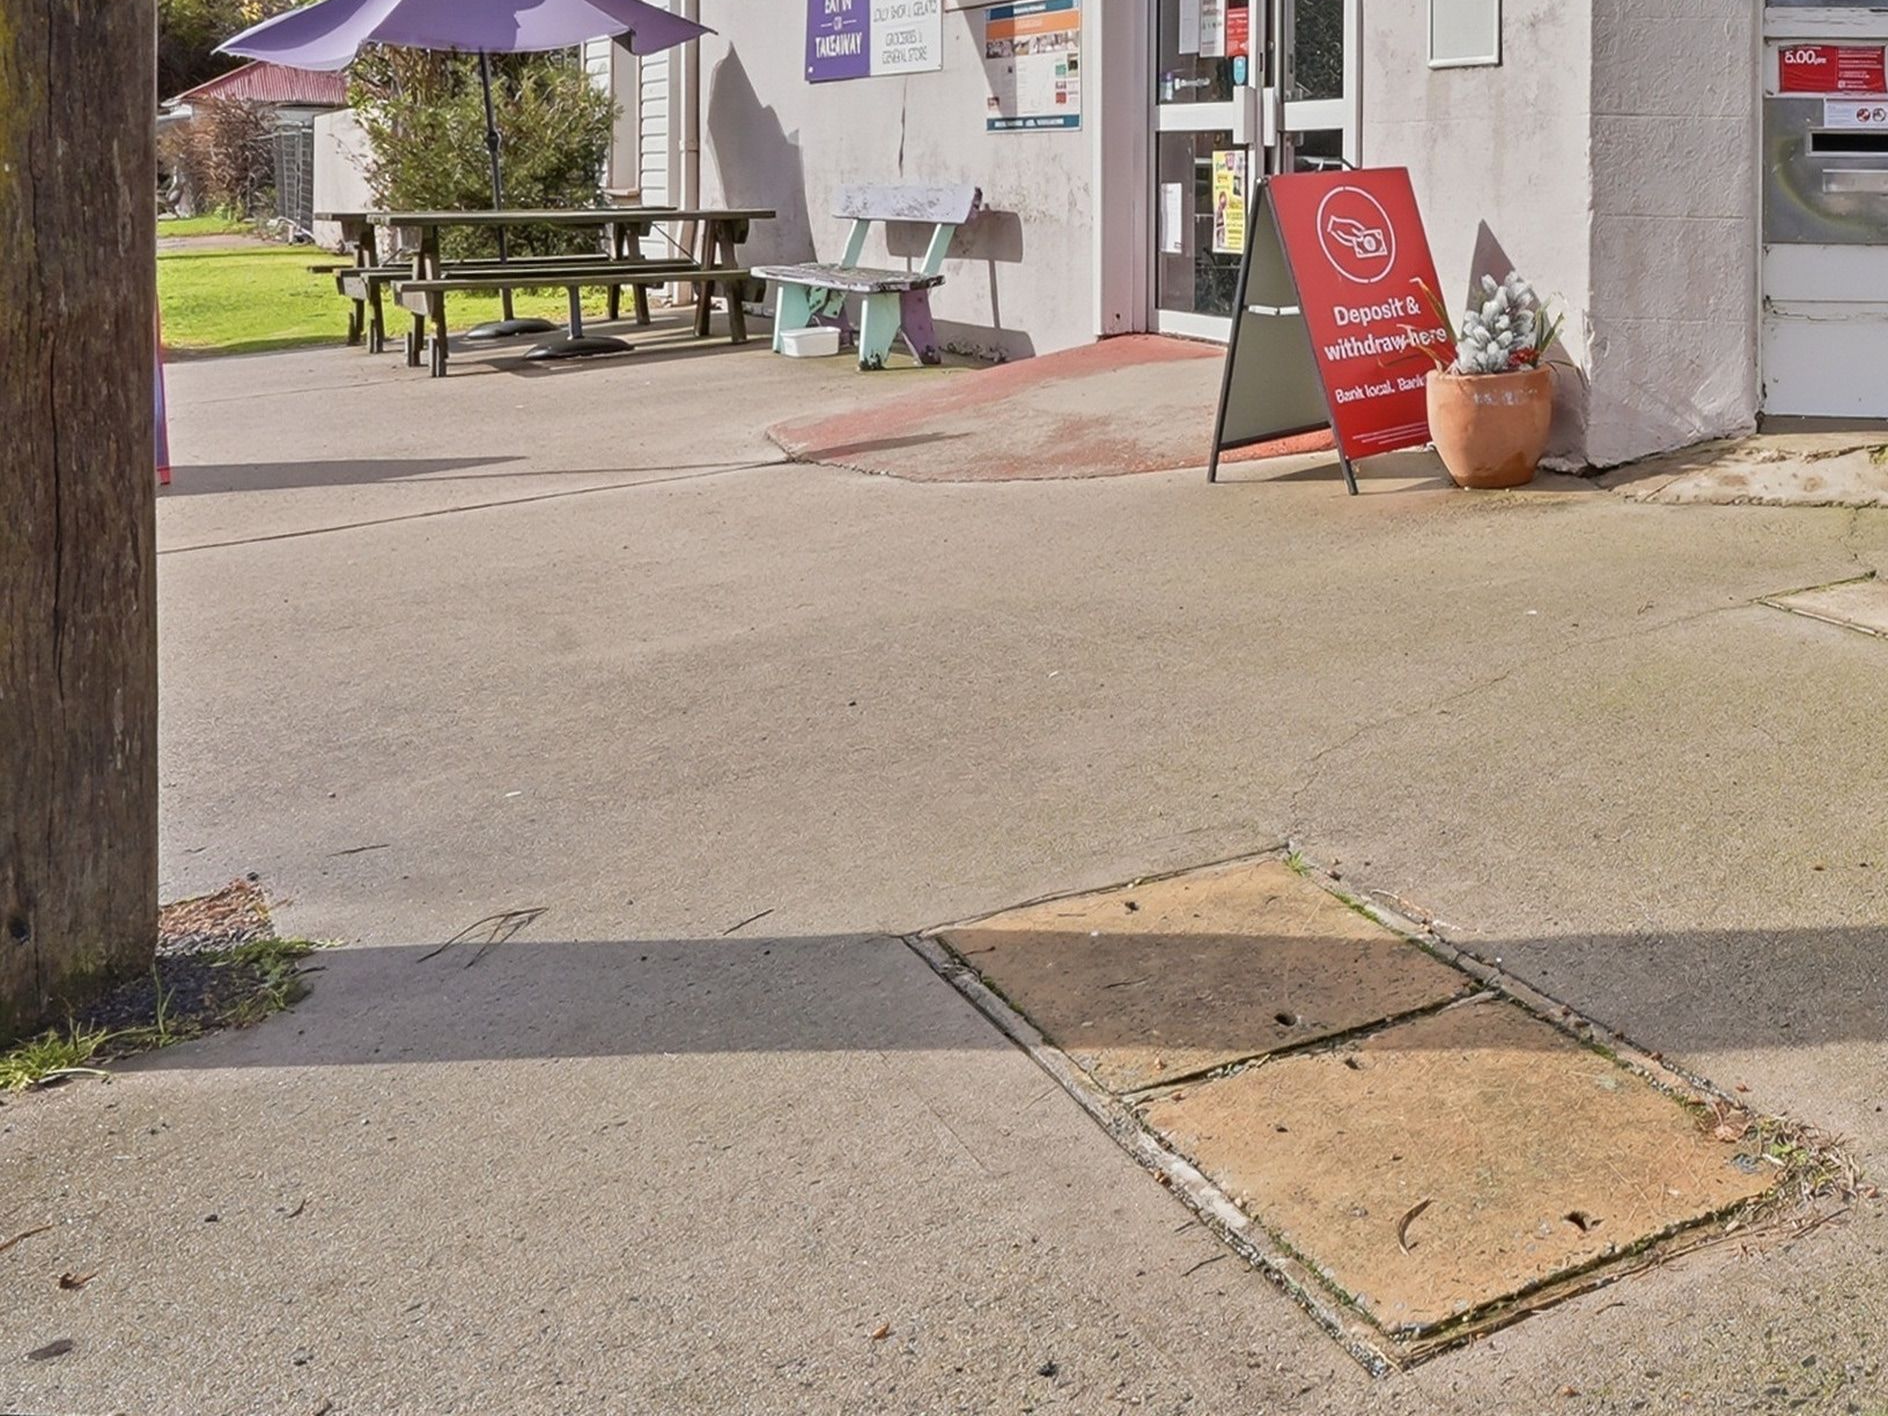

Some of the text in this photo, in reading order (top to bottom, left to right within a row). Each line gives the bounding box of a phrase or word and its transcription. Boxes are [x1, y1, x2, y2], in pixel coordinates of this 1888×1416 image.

[815, 32, 862, 58] TAKEAWAY
[1333, 296, 1421, 326] Deposit &
[1324, 326, 1447, 361] withdraw here
[1335, 386, 1365, 403] Bank
[1366, 380, 1396, 398] local.
